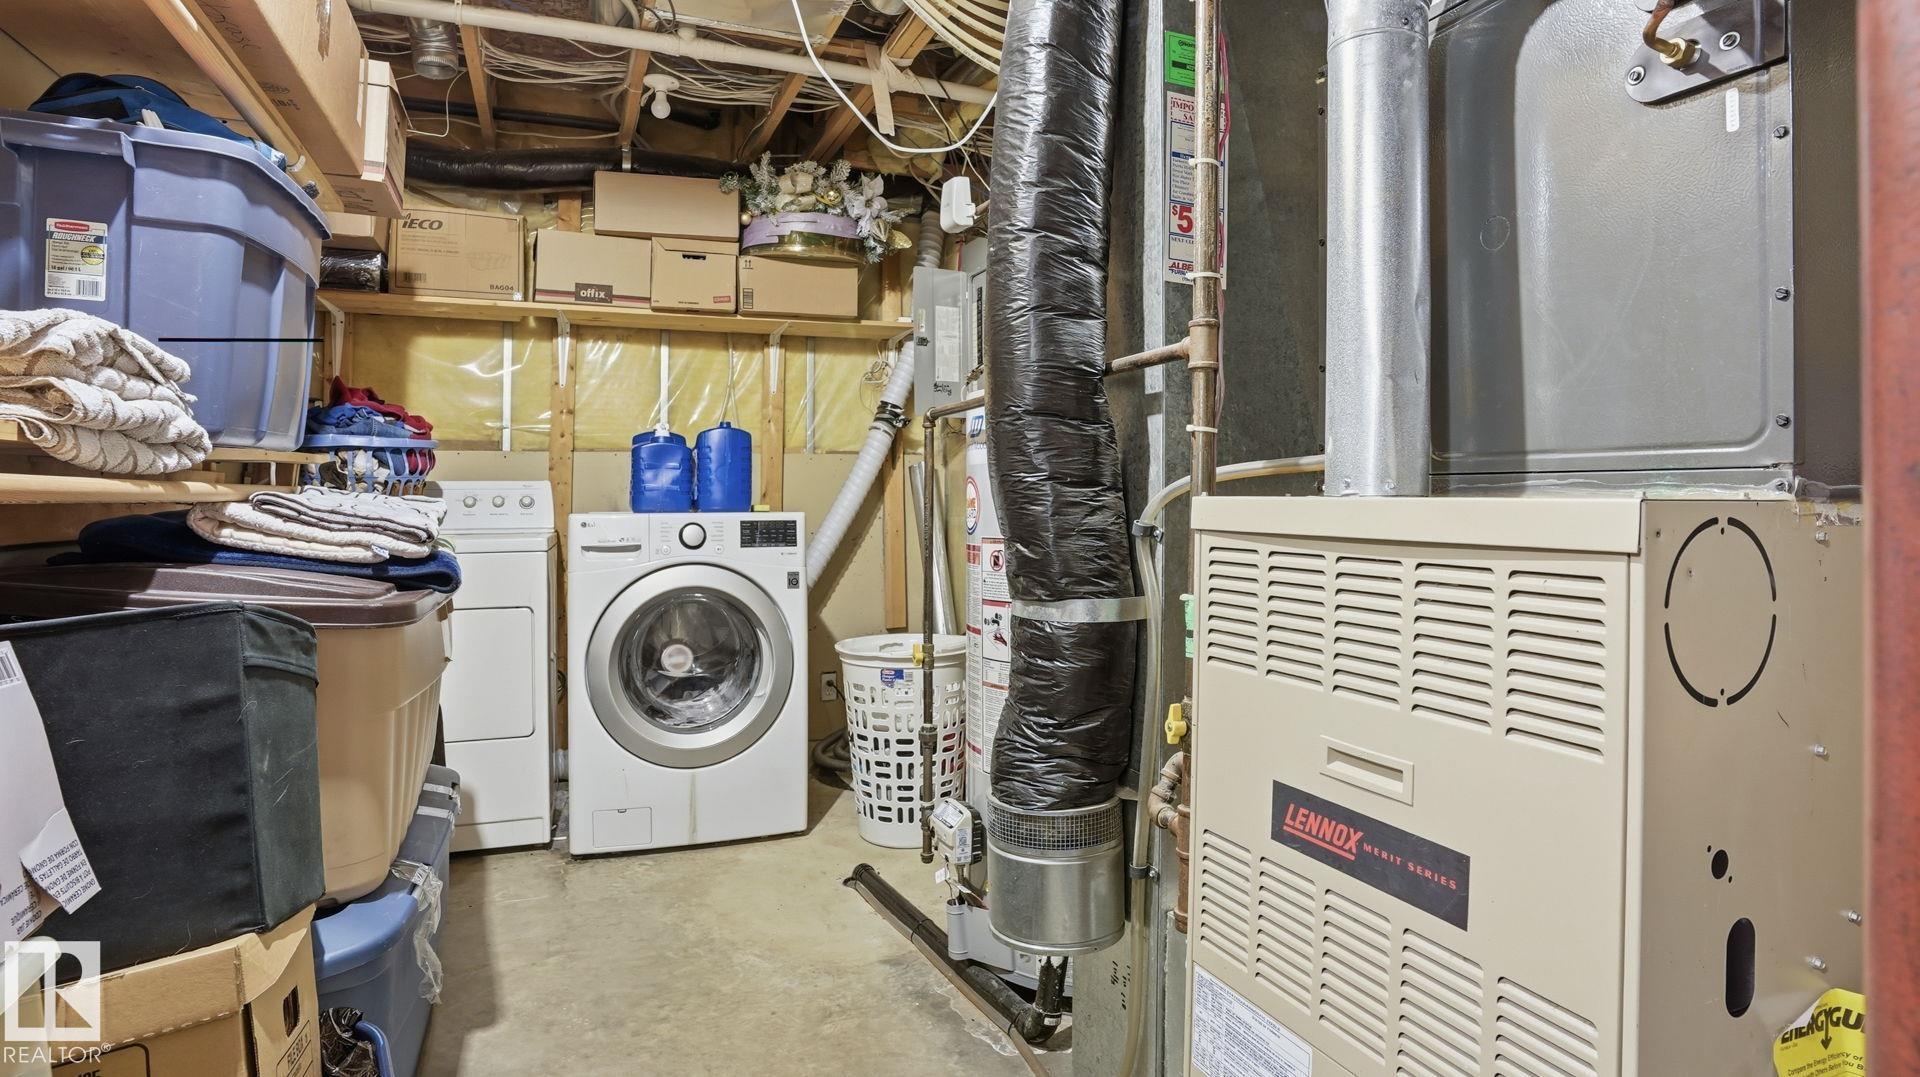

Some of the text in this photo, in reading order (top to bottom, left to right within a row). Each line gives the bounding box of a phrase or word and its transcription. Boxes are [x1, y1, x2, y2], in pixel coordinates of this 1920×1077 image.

[1172, 100, 1195, 112] IMPO
[1183, 113, 1194, 121] SA
[52, 232, 97, 243] ROUGHNECK
[1169, 261, 1194, 271] ALBE
[580, 288, 606, 299] offix
[1285, 803, 1364, 854] LENNOX
[1363, 842, 1457, 891] MERIT SERIES
